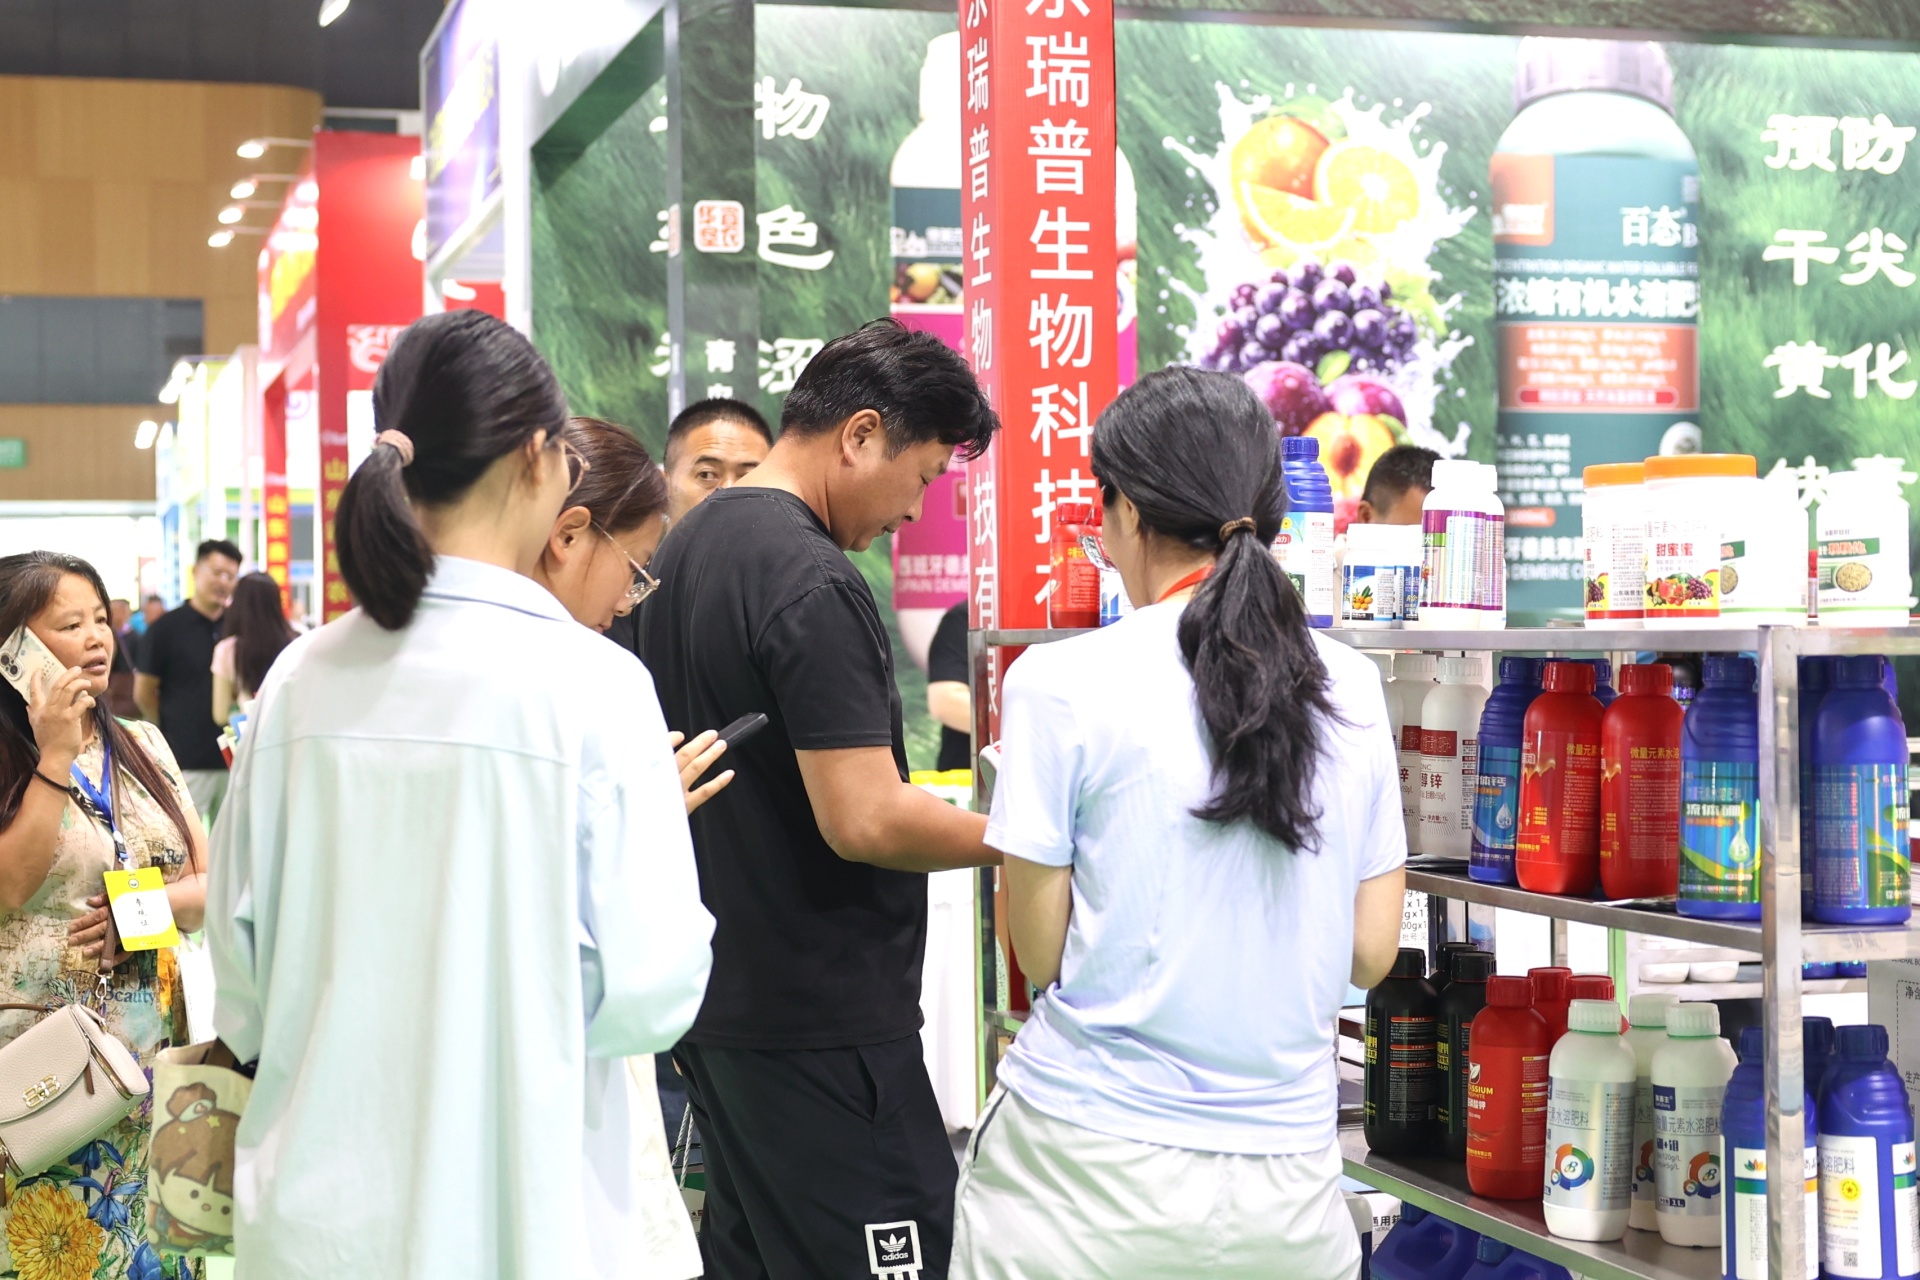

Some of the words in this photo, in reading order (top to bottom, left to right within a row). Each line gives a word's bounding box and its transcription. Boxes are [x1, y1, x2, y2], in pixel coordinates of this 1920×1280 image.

[1760, 113, 1917, 175] 预防
[1620, 205, 1682, 247] 百态
[1761, 227, 1917, 288] 干尖
[1025, 0, 1097, 631] 瑞普生物科技
[1762, 340, 1918, 401] 黄化
[1656, 543, 1693, 556] 甜蜜蜜
[1671, 1198, 1685, 1207] 1L
[881, 1252, 909, 1261] adidas
